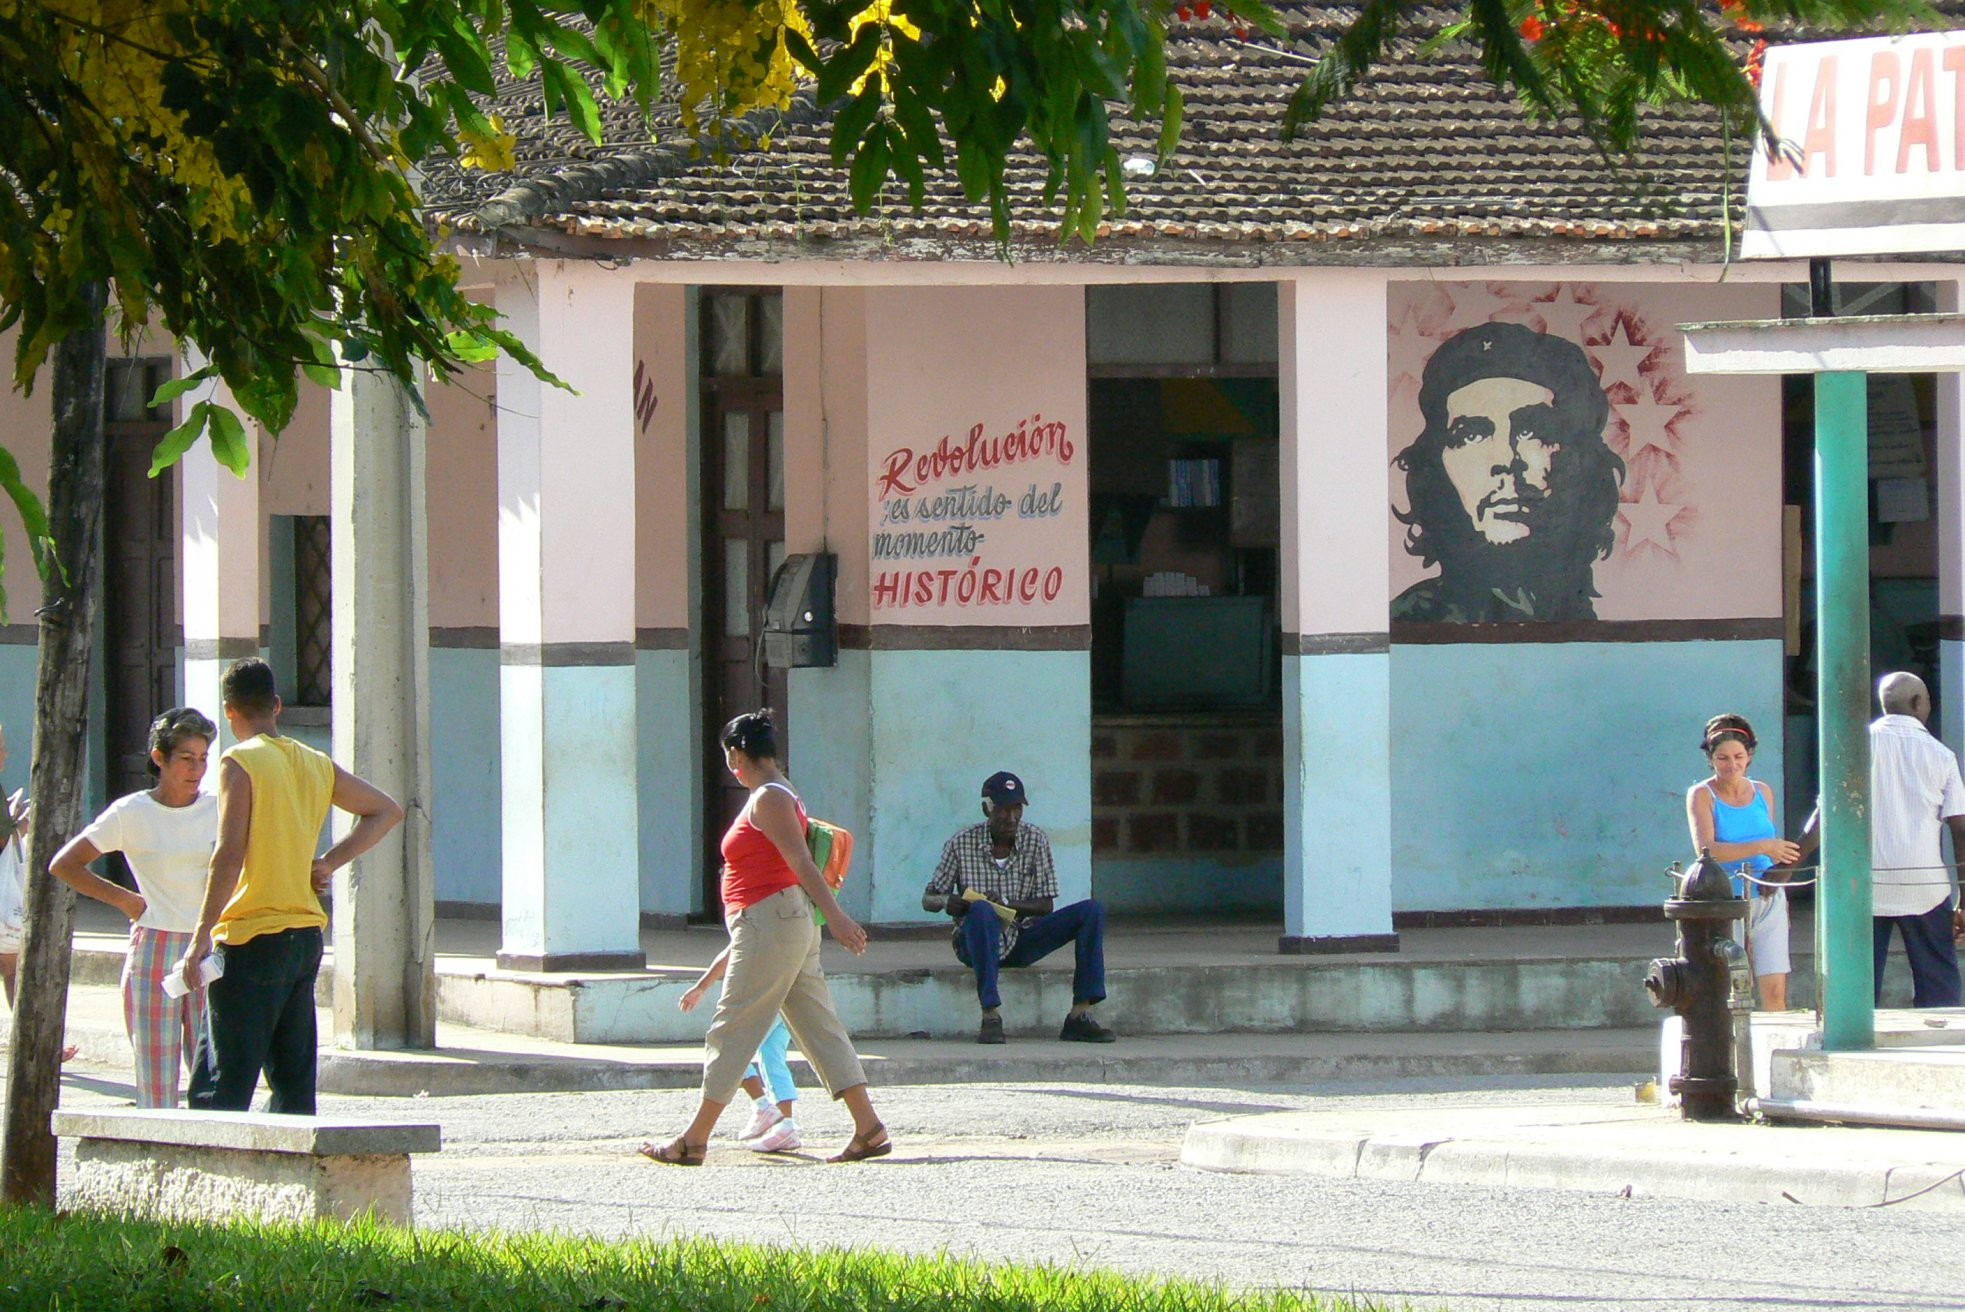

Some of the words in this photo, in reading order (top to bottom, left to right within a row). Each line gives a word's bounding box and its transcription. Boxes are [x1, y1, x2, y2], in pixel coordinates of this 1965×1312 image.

[1767, 55, 1838, 181] LA
[878, 413, 1074, 501] Revolución
[915, 484, 1012, 522] sentido
[1017, 482, 1063, 520] del
[872, 524, 985, 561] momento
[873, 555, 1063, 609] HISTÓRICO
